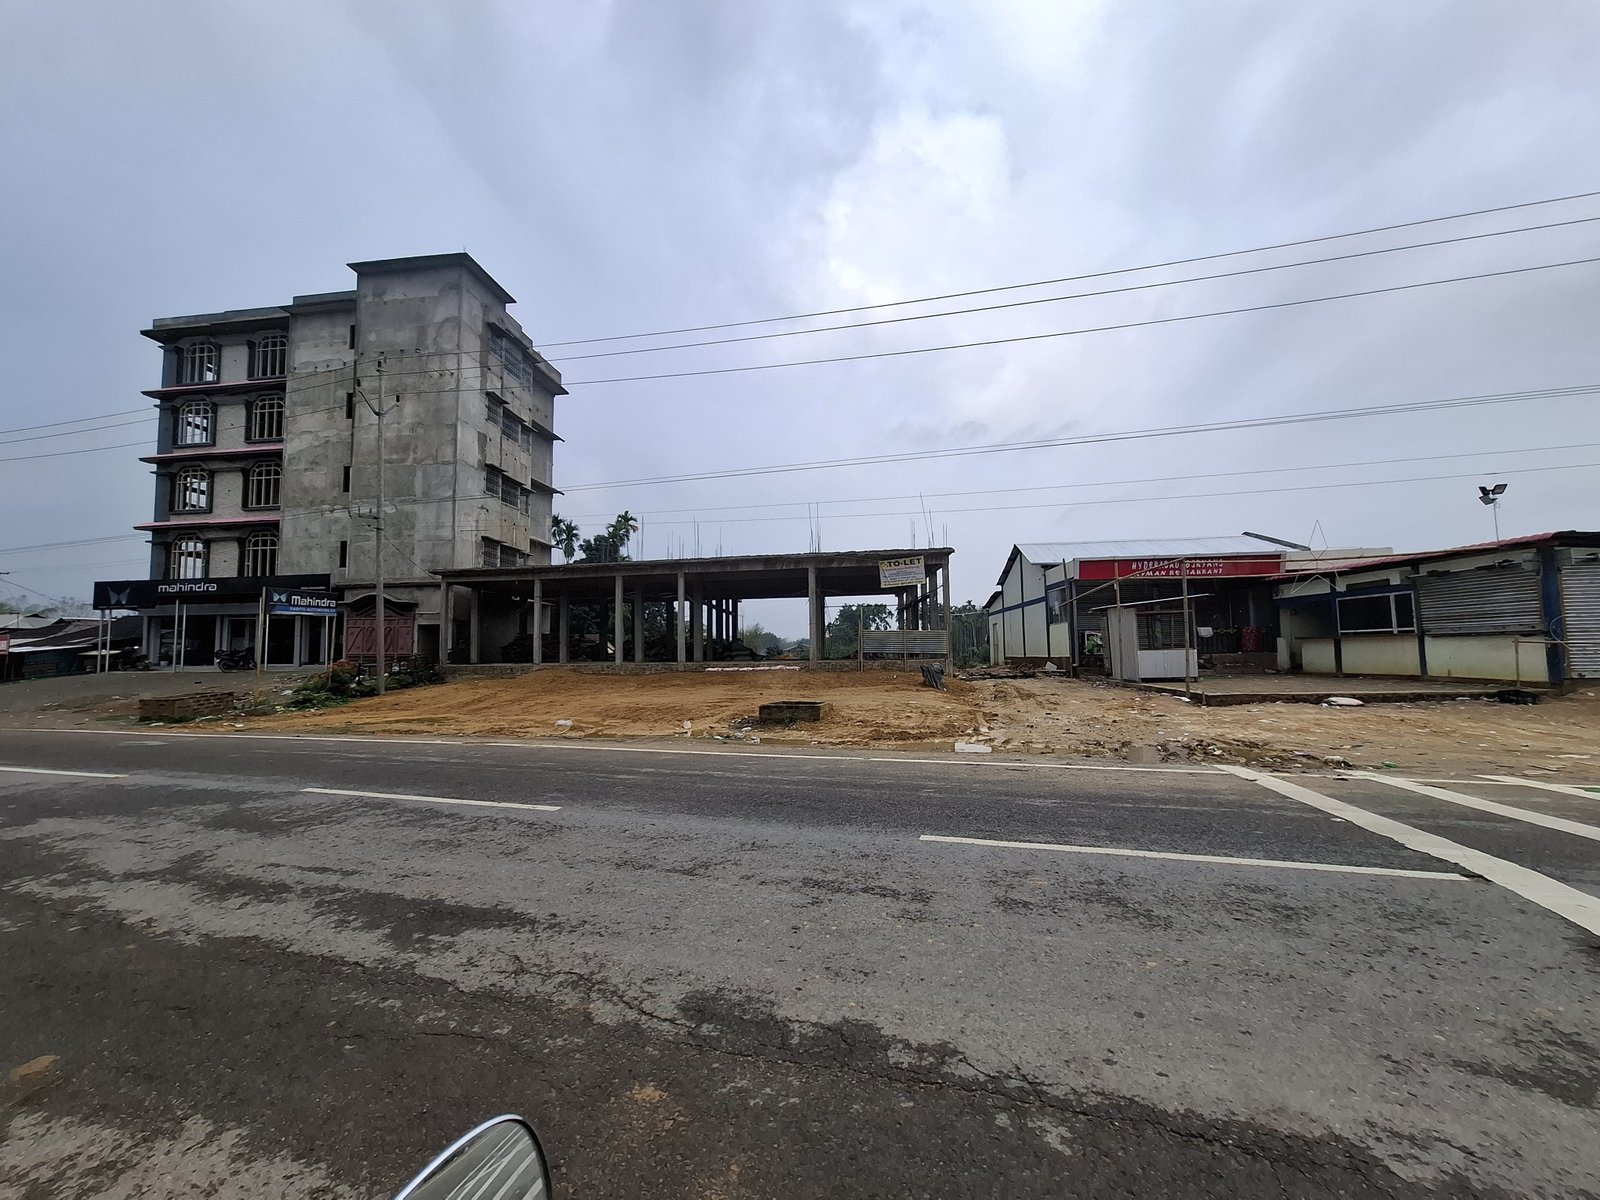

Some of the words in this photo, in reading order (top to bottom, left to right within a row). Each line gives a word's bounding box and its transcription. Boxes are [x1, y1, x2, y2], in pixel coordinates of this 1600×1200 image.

[1169, 568, 1223, 576] RETAURANT
[158, 582, 217, 592] mahindra
[291, 595, 336, 607] Mahindra
